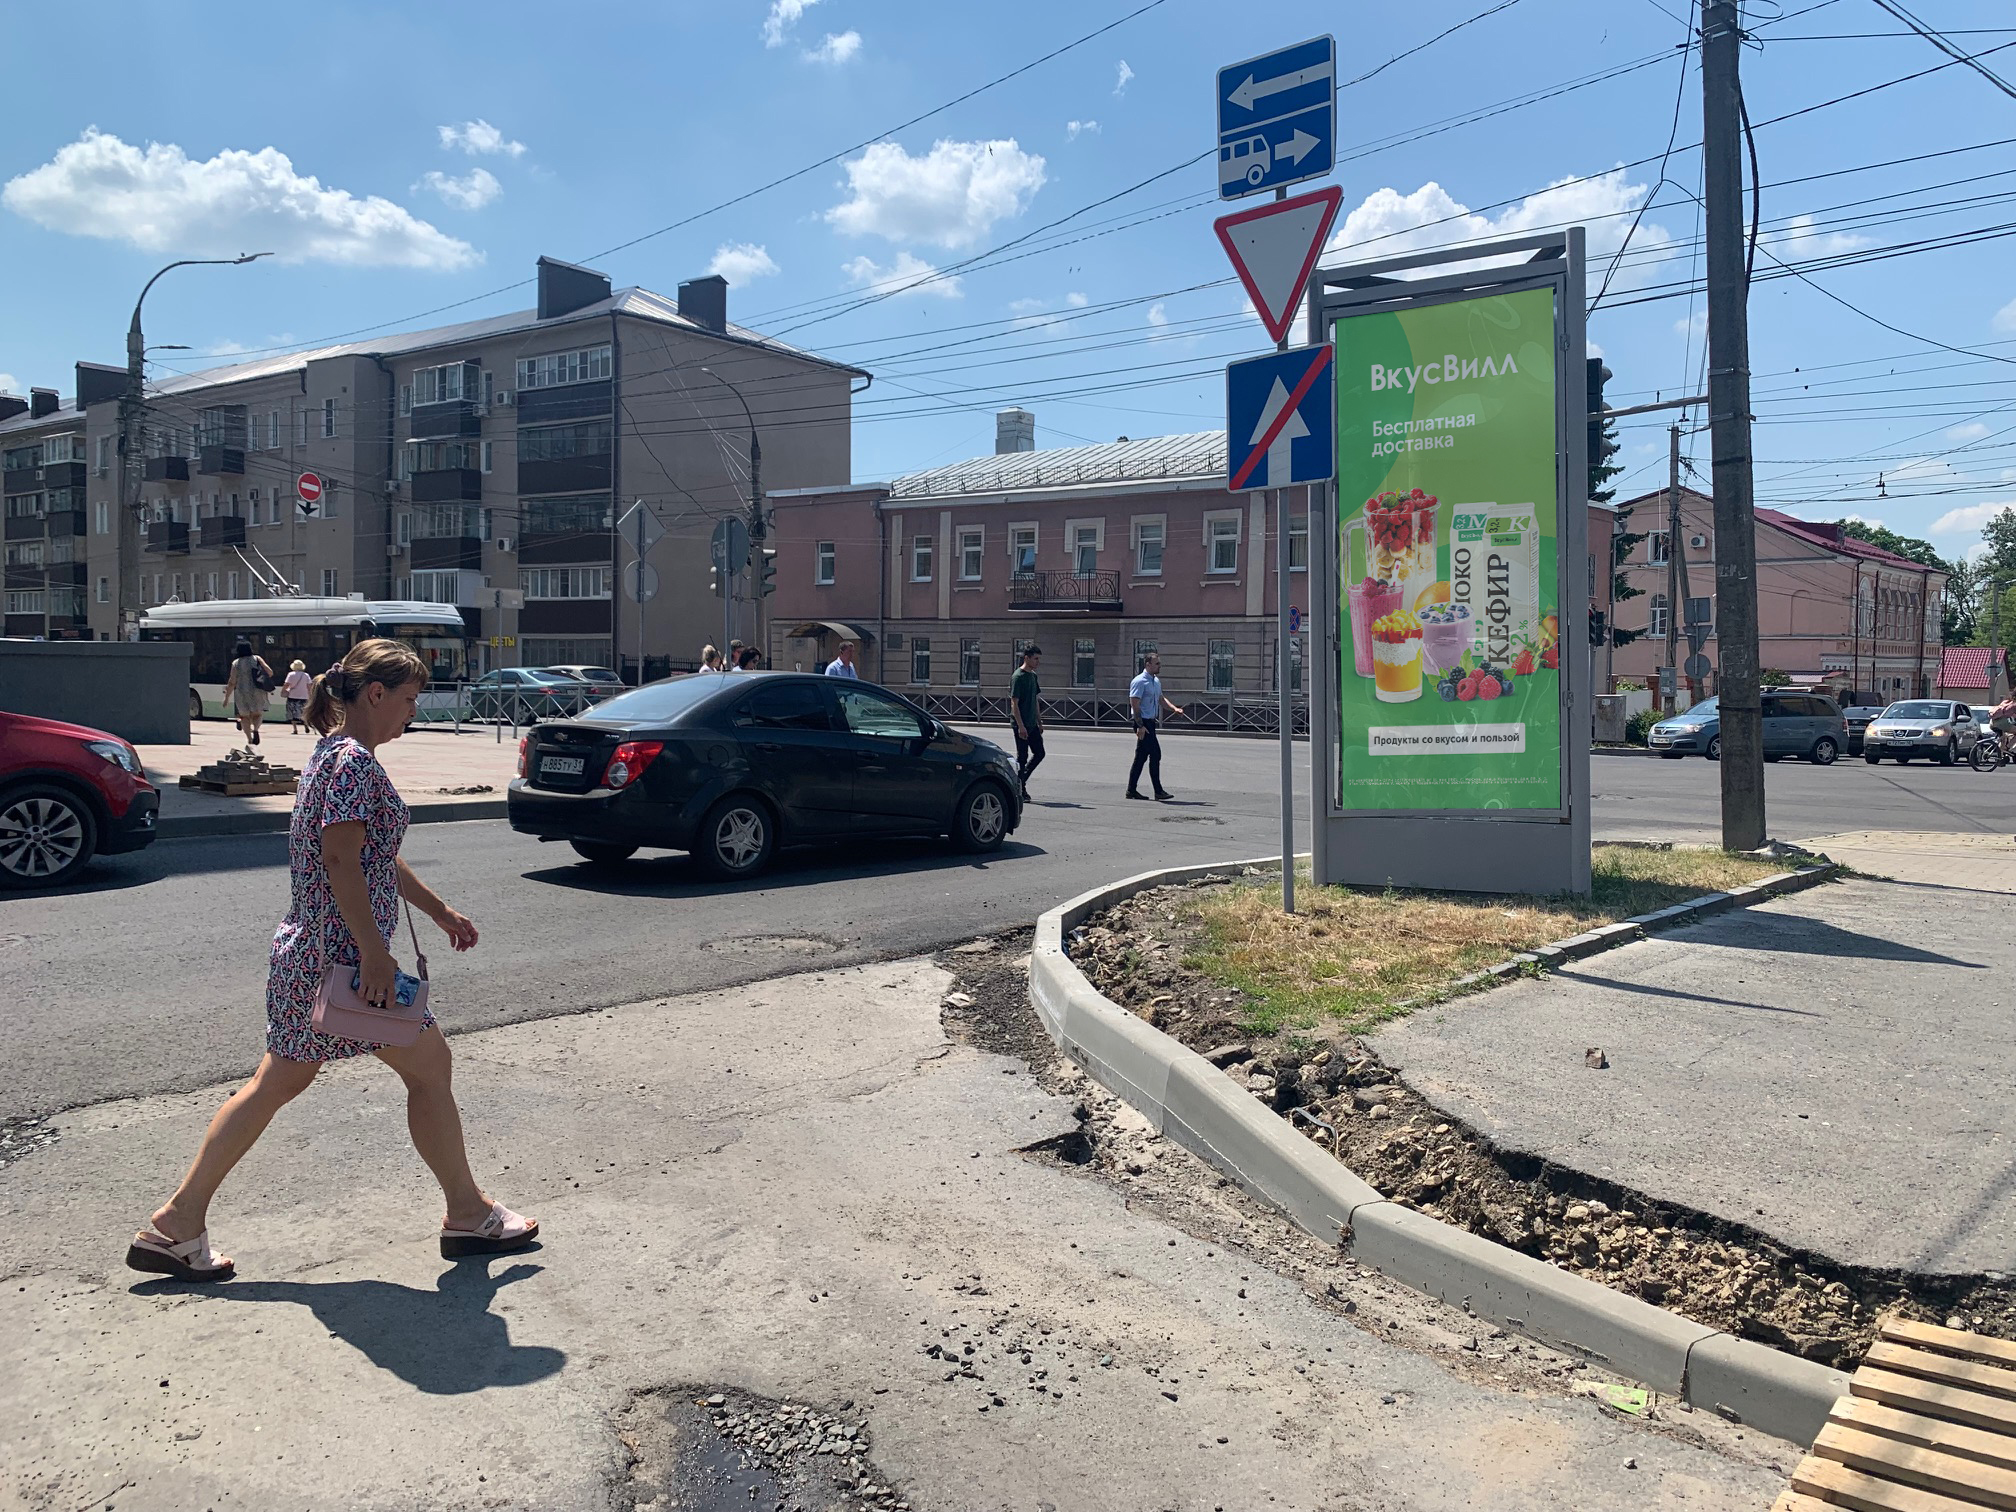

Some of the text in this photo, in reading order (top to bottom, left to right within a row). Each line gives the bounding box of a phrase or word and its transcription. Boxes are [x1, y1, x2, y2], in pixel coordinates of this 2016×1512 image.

[1371, 353, 1519, 394] ВкусВилл
[1373, 413, 1476, 437] Бесплатная
[1371, 434, 1454, 458] доставка
[1507, 515, 1529, 532] К
[1486, 553, 1511, 665] КЕФИР
[1373, 732, 1520, 746] Продукты со вкусом и пользой
